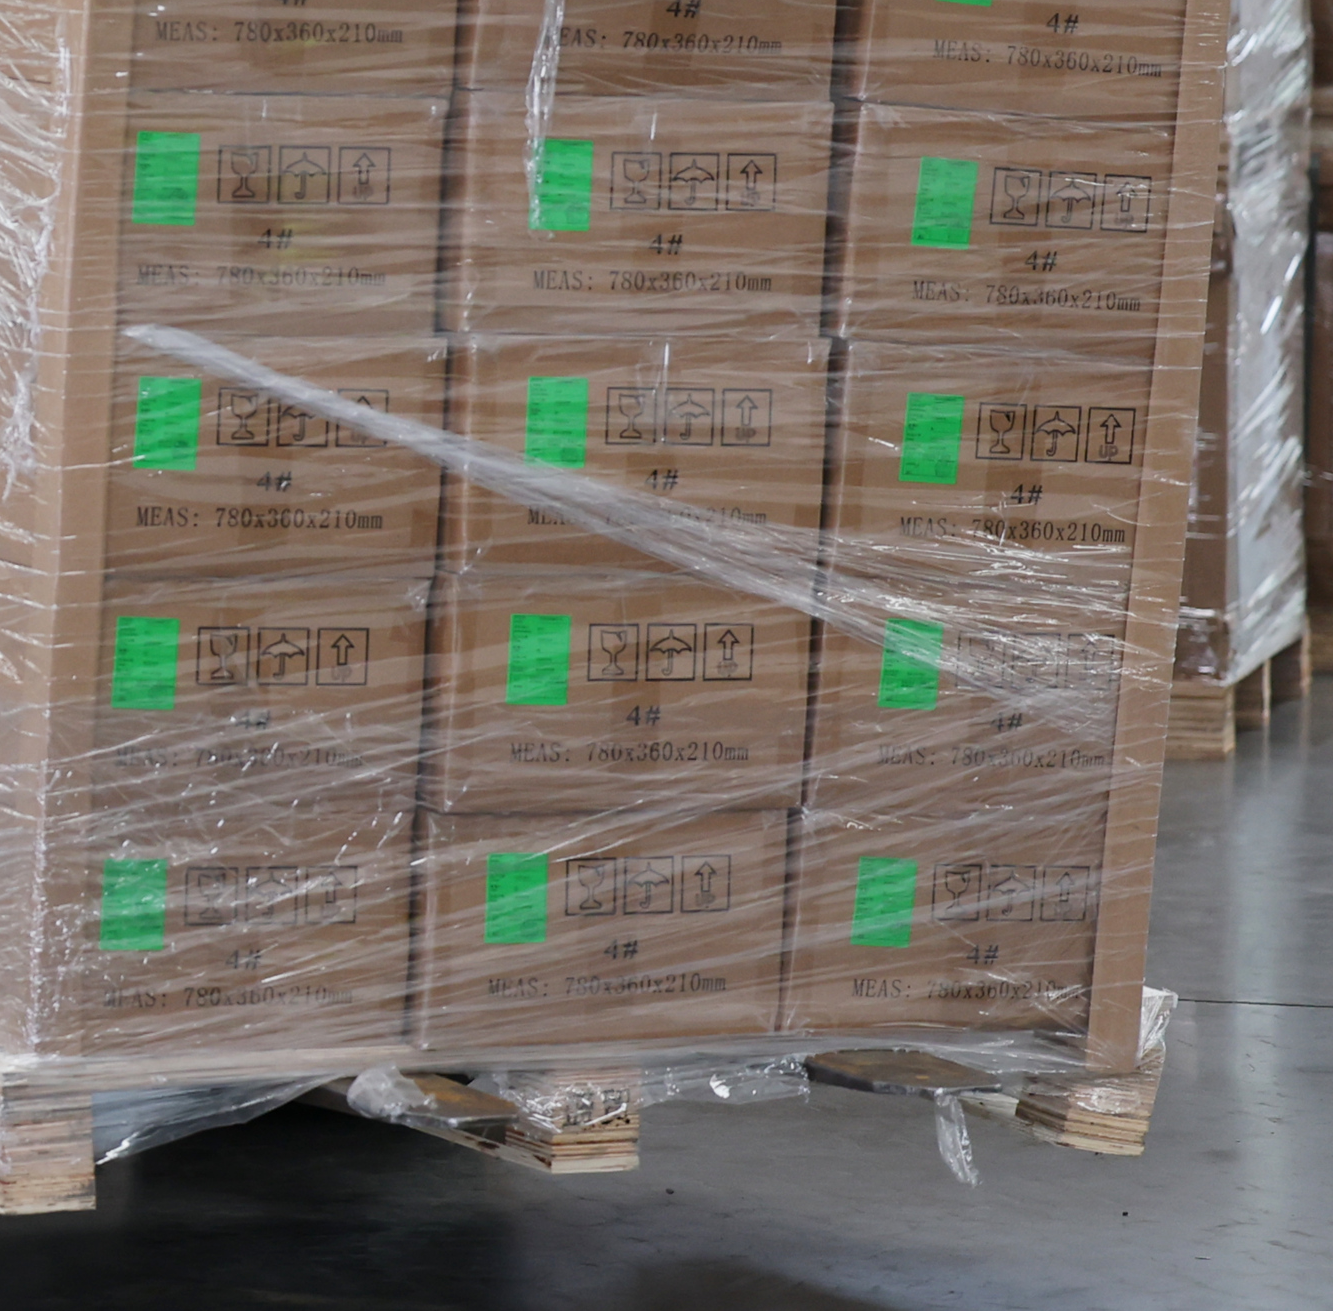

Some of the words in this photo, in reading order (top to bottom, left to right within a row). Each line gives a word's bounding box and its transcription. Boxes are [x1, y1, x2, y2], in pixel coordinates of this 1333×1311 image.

[155, 21, 218, 42] MEAS:
[234, 22, 402, 43] 780x360x210mm
[1047, 13, 1078, 34] 4#
[543, 27, 607, 49] EAS:
[623, 30, 782, 54] 780x360x210mm
[933, 39, 991, 63] MEAS:
[1007, 45, 1162, 78] 780x360x210mm
[257, 228, 294, 249] 4#
[649, 234, 683, 255] 4#
[1026, 251, 1057, 272] 4#
[137, 265, 199, 286] MEAS:
[533, 270, 594, 291] MEAS:
[610, 271, 772, 291] 780x360x210mm
[912, 280, 970, 302] MEAS:
[256, 471, 293, 491] 4#
[645, 469, 678, 490] 4#
[1011, 484, 1042, 505] 4#
[137, 506, 199, 528] MEAS:
[216, 508, 382, 529] 780x360x210mm
[900, 517, 956, 538] MEAS:
[972, 518, 1126, 543] 780x360x210mm
[626, 705, 661, 726] 4#
[510, 742, 571, 763] MEAS:
[586, 741, 749, 762] 780x360x210mm
[877, 745, 935, 766] MEAS:
[225, 949, 262, 970] 4#
[604, 939, 638, 960] 4#
[967, 945, 998, 964] 4#
[488, 978, 549, 998] MEAS:
[565, 973, 726, 995] 780x360x210mm
[852, 978, 911, 998] MEAS:
